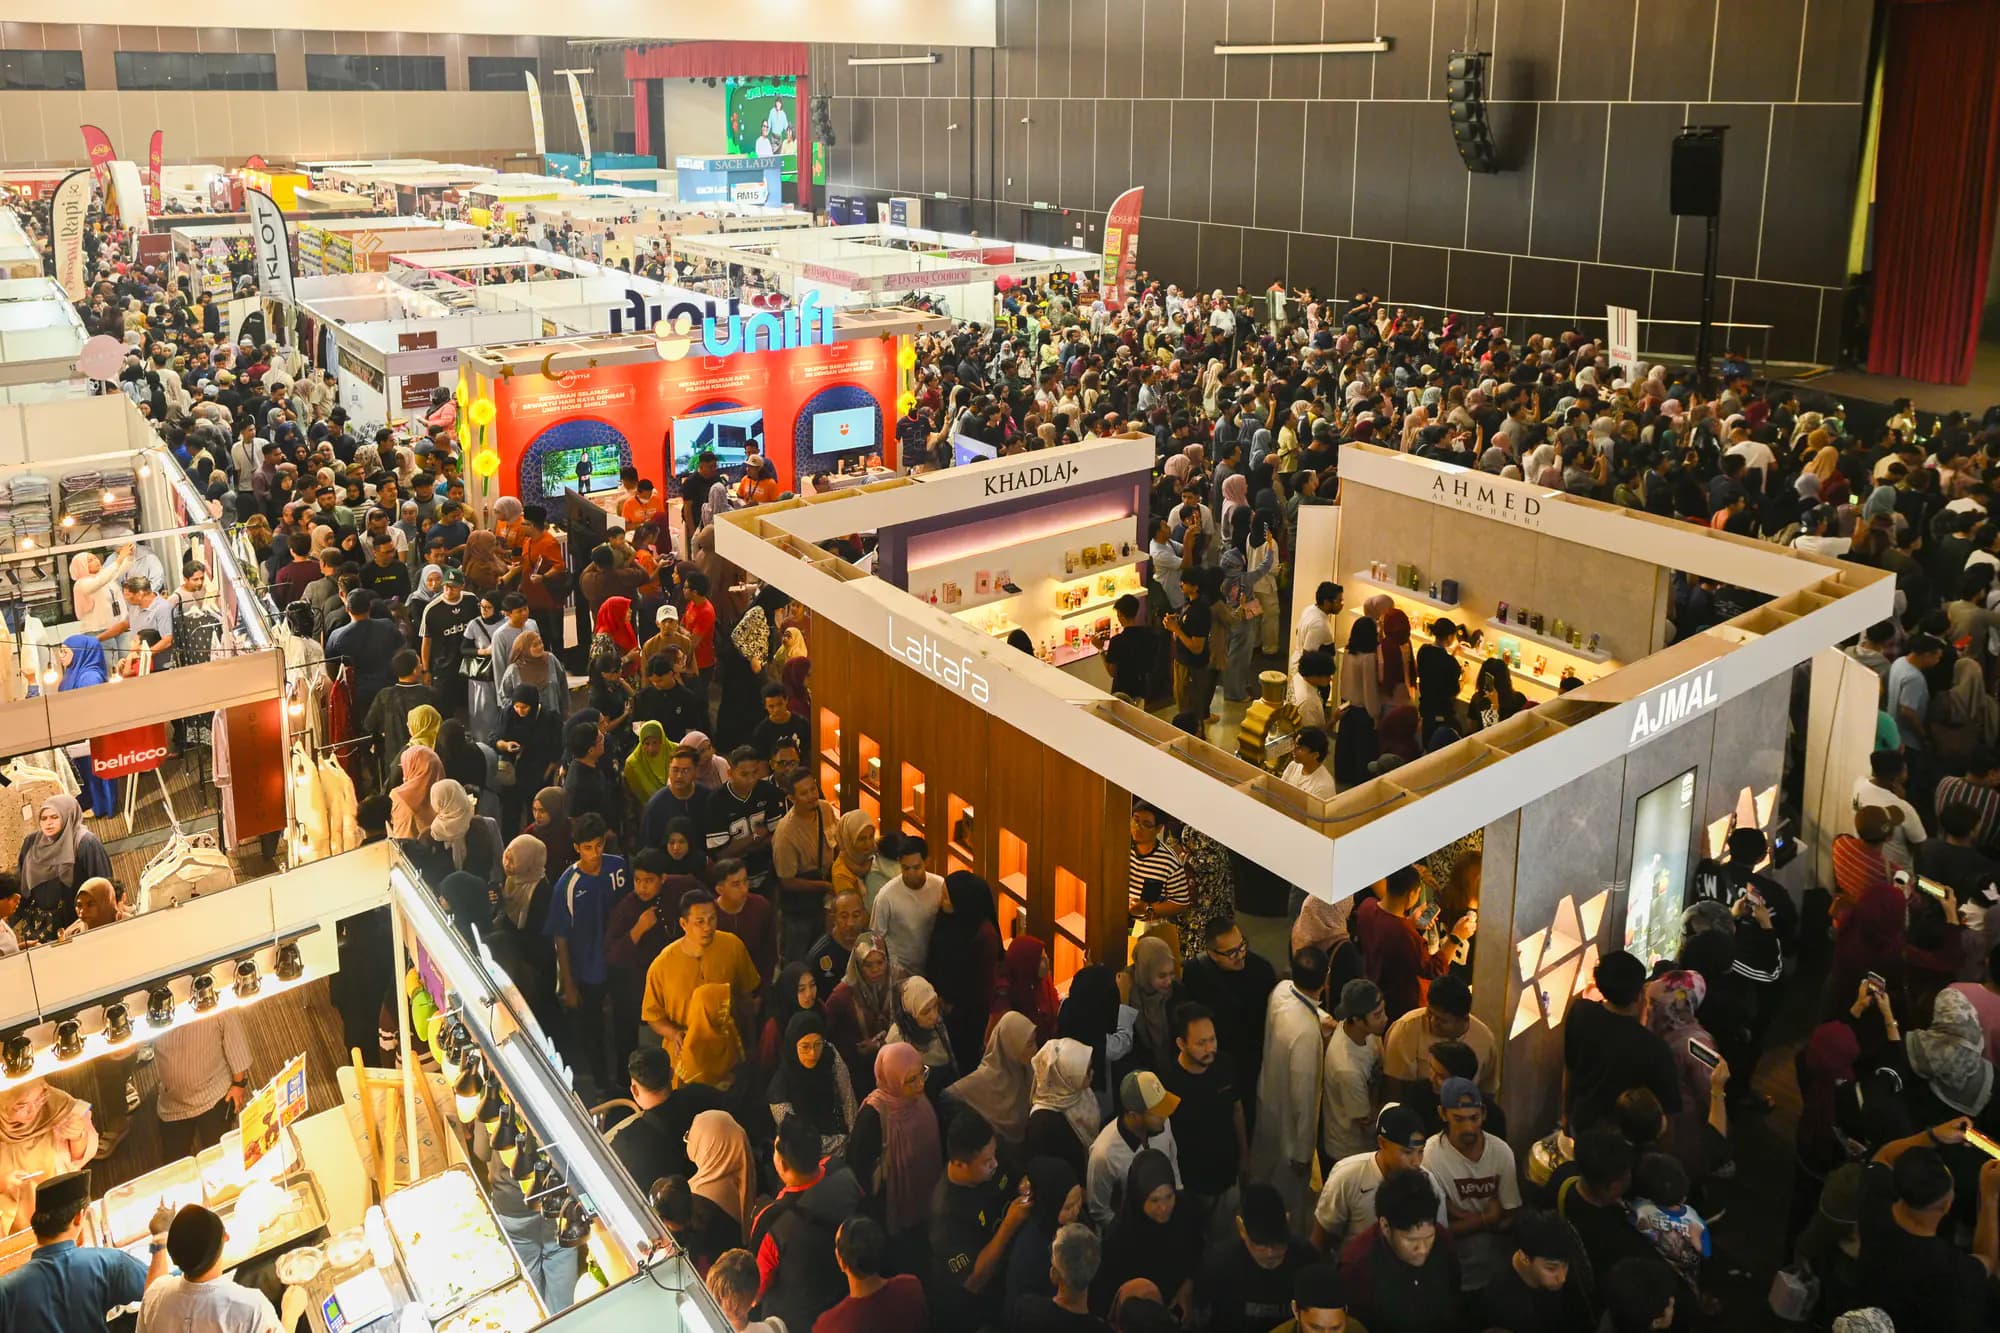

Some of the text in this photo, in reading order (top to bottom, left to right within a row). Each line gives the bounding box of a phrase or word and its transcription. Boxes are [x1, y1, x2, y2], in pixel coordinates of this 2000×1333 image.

[715, 158, 776, 169] SACE LADY
[736, 192, 759, 200] RM15
[258, 208, 280, 280] KLOT
[896, 270, 968, 286] Dyang Couture
[702, 288, 835, 357] unifi
[584, 400, 607, 408] SHIELD
[985, 460, 1072, 496] KHADLAJ
[1432, 475, 1541, 516] AHMED
[444, 622, 468, 636] adid
[888, 615, 989, 704] Lattafa
[1630, 670, 1718, 743] AJMAL
[94, 747, 168, 772] belricco
[609, 868, 625, 892] 16
[1696, 872, 1718, 899] EW
